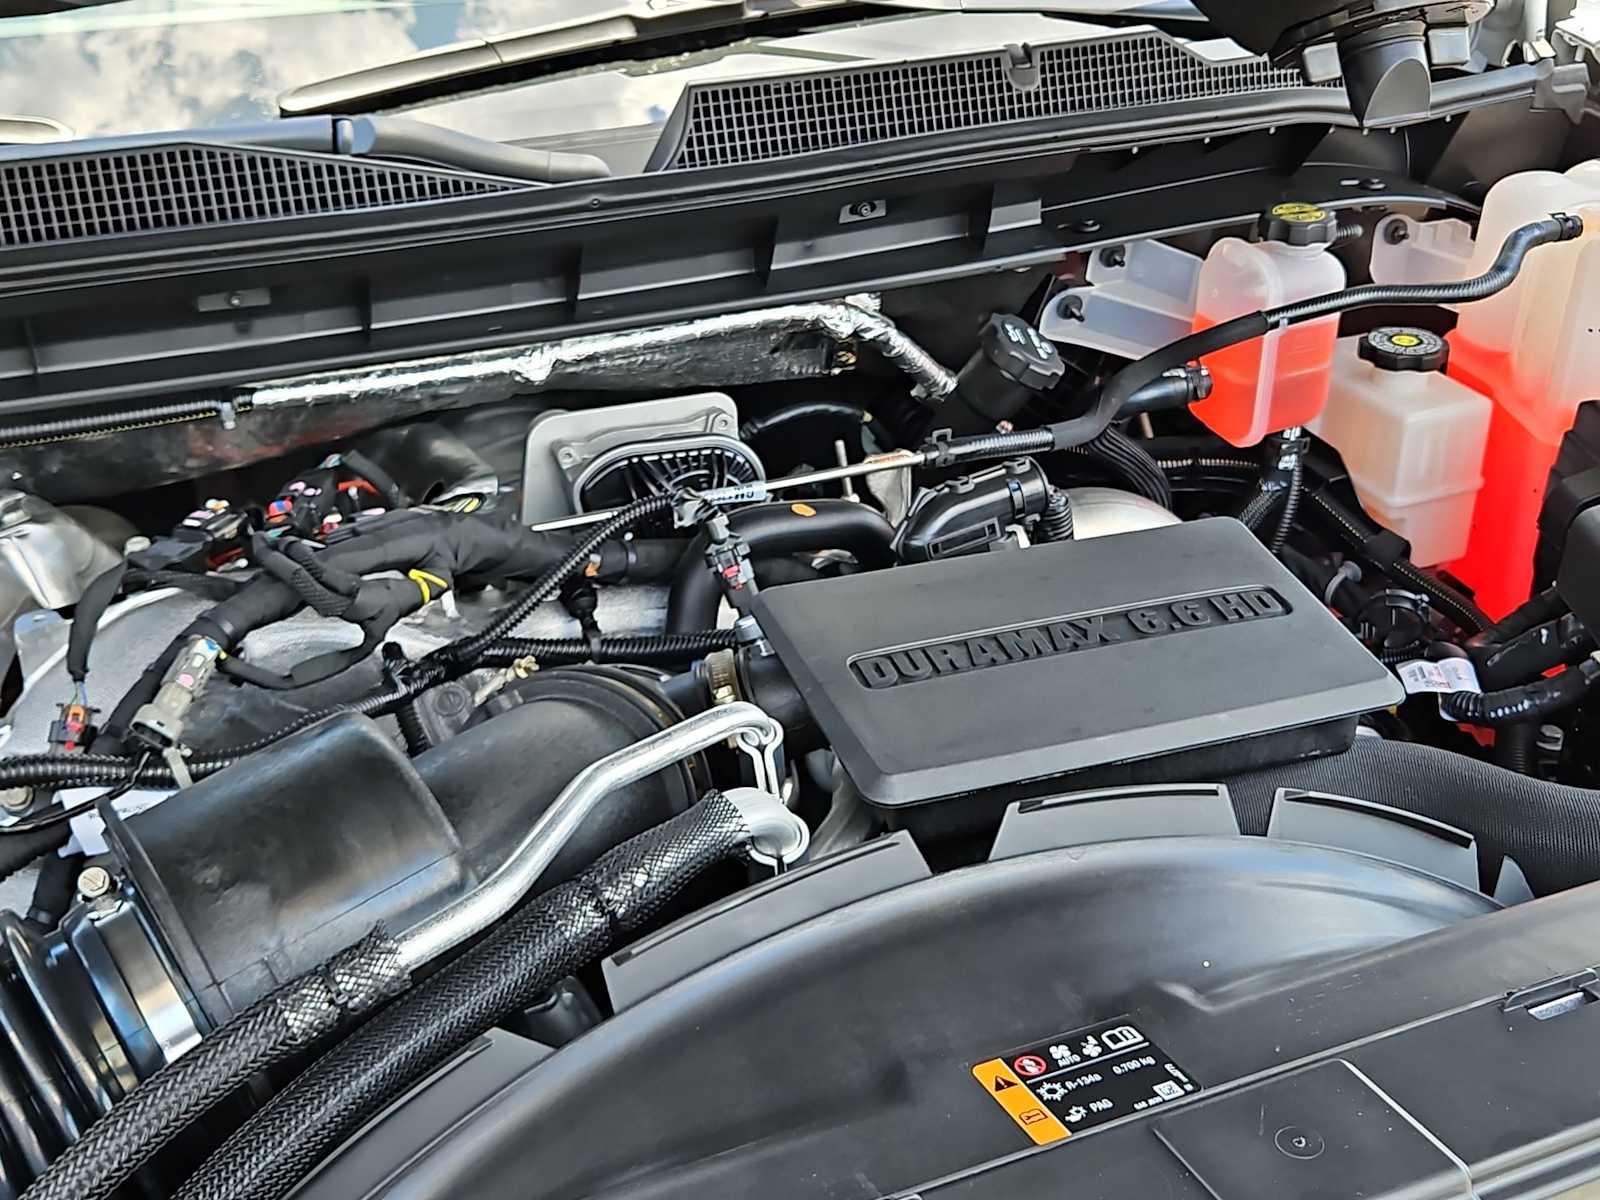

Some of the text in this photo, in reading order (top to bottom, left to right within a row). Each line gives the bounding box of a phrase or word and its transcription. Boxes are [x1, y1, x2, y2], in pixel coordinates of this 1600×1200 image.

[855, 590, 1285, 688] DURAMAX 6.6 HD
[1057, 1054, 1081, 1068] AUTO
[1065, 1056, 1156, 1090] R-134a 0.700 kg
